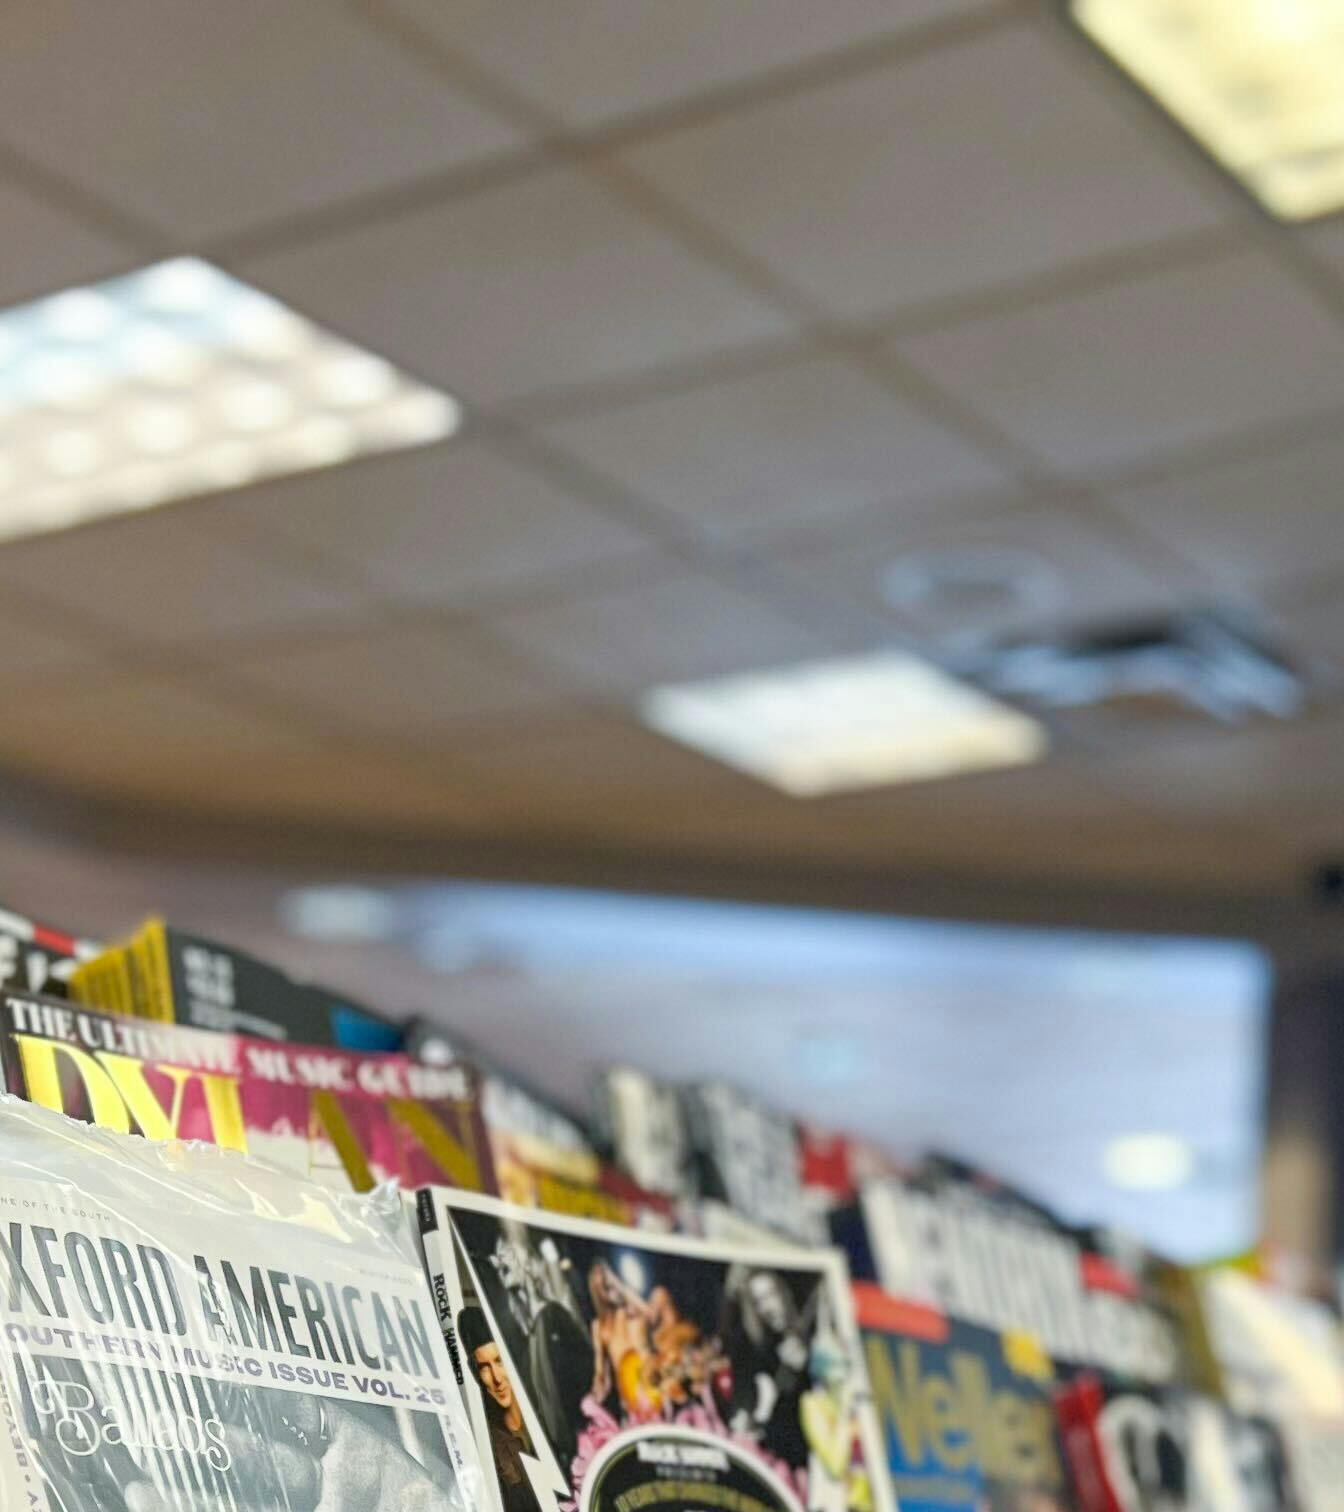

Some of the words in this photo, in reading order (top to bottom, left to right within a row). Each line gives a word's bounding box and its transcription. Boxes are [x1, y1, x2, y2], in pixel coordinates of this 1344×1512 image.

[192, 1254, 442, 1381] AMERICAN
[433, 1272, 452, 1322] ROCK
[269, 1361, 350, 1391] ISSUE
[352, 1375, 411, 1401] VOL.
